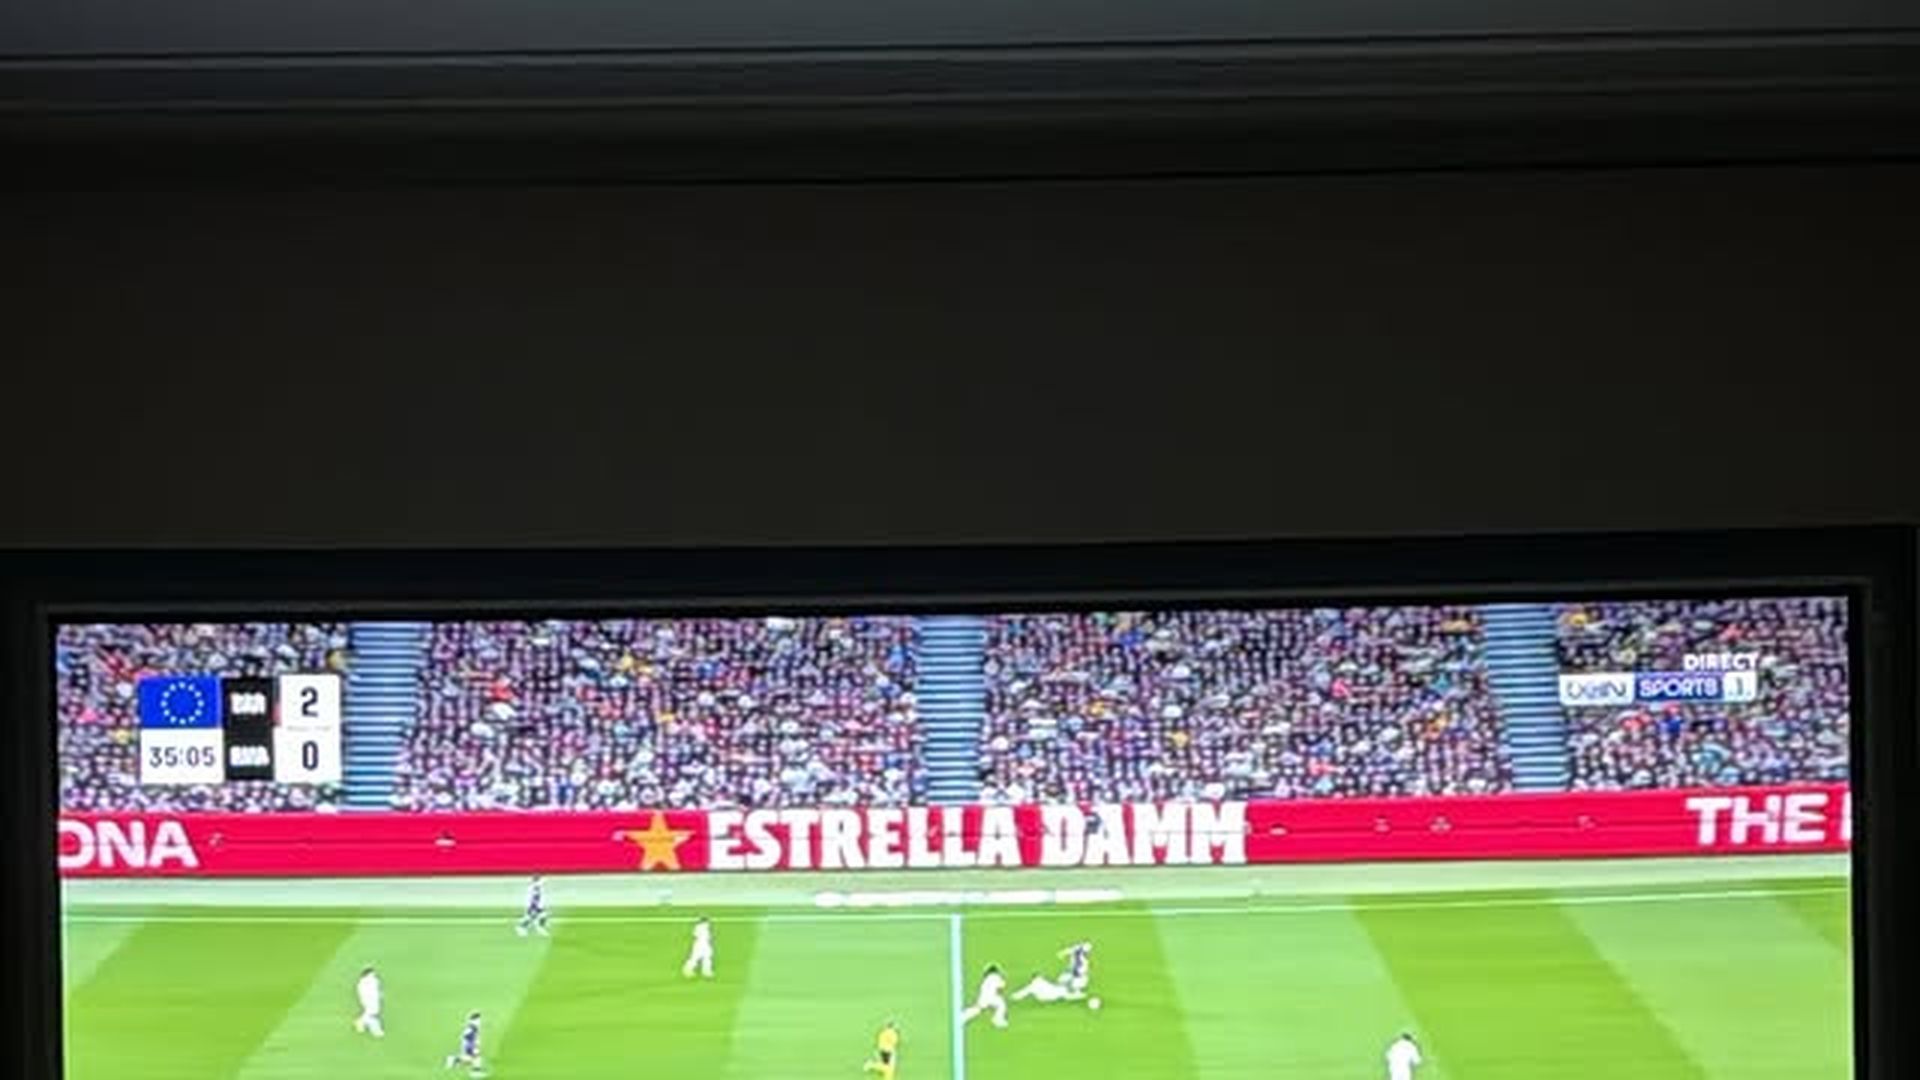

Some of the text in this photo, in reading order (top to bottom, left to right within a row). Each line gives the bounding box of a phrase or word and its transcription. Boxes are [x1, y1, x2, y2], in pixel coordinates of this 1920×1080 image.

[1683, 654, 1759, 671] DIRECT
[300, 686, 319, 718] 2
[1639, 678, 1718, 697] SPORTS
[149, 746, 216, 768] 35:05
[302, 740, 319, 771] 0
[709, 799, 1247, 869] ESTRELLA DAMM
[1686, 793, 1829, 845] THE
